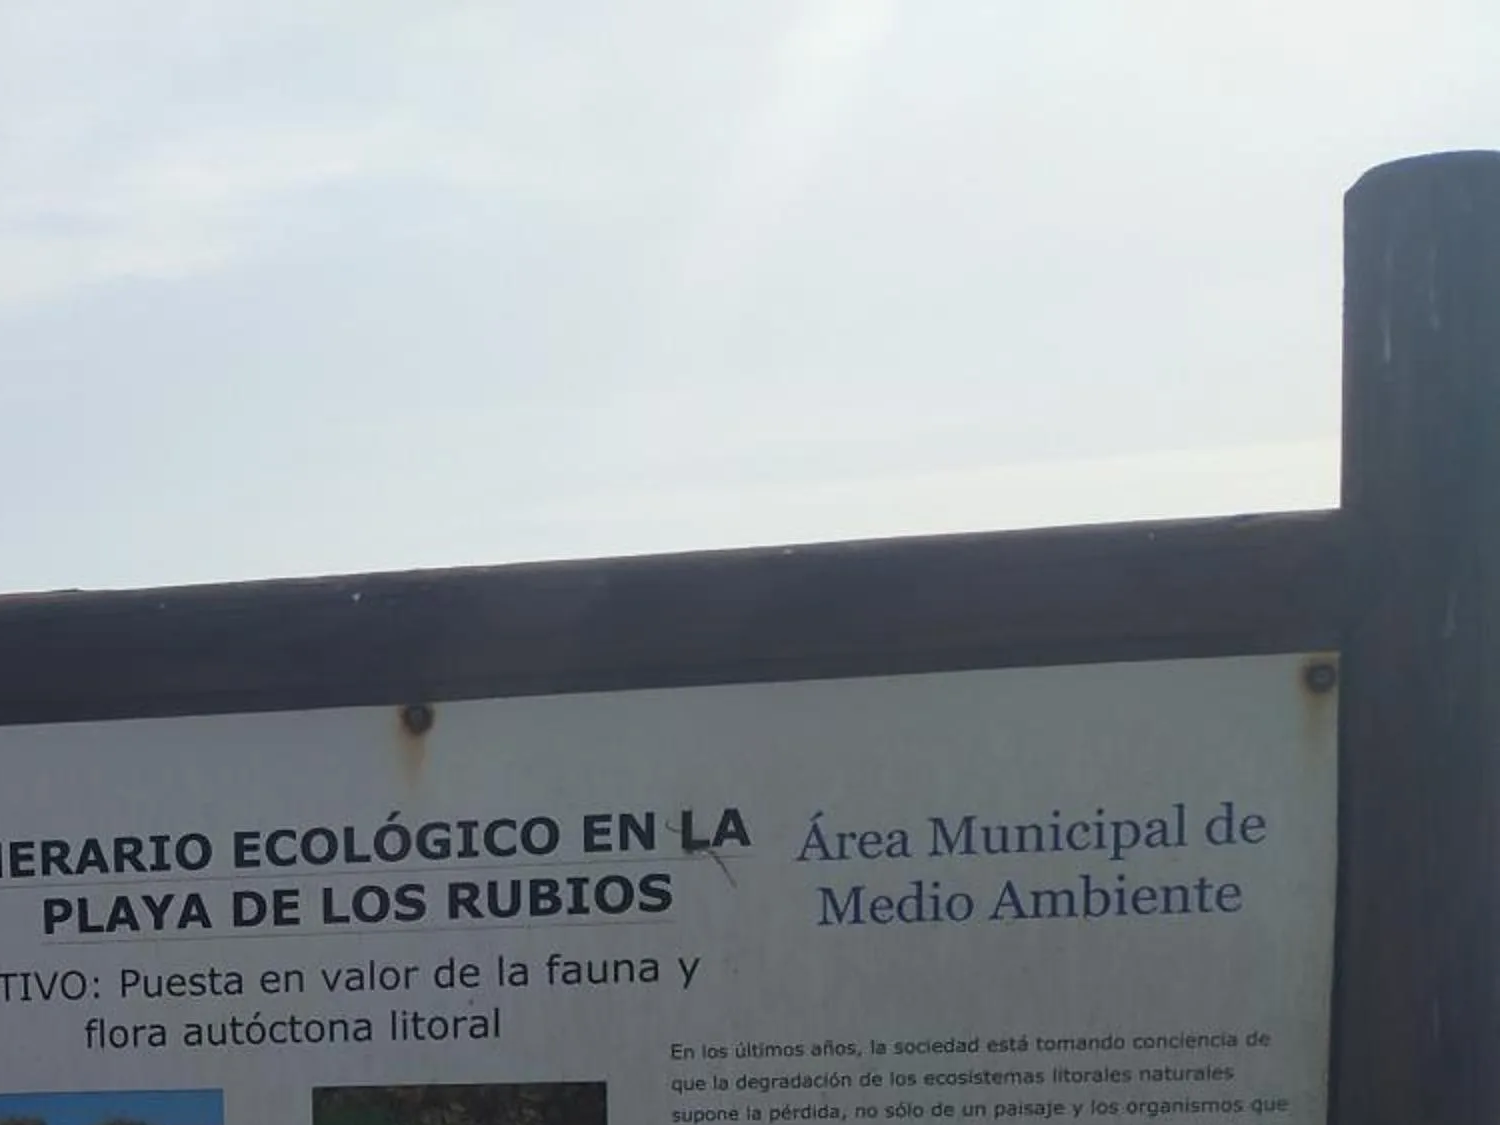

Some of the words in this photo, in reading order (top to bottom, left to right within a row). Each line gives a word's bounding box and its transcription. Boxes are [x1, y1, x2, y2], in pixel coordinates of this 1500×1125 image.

[234, 811, 559, 868] ECOLÓGICO
[584, 812, 655, 852] EN
[681, 808, 751, 851] LA
[796, 811, 911, 861] Área
[929, 803, 1186, 861] Municipal
[1205, 802, 1265, 845] de
[44, 893, 212, 934] PLAYA
[233, 889, 300, 927] DE
[323, 884, 426, 924] LOS
[449, 874, 672, 919] RUBIOS
[818, 880, 974, 925] Medio
[989, 874, 1241, 920] Ambiente
[121, 968, 243, 998] Puesta
[260, 970, 304, 994] en
[322, 960, 419, 992] valor
[434, 957, 480, 988] de
[498, 956, 528, 986] la
[546, 954, 658, 985] fauna
[678, 958, 700, 989] y
[85, 1018, 166, 1048] flora
[184, 1012, 372, 1046] autóctona
[391, 1007, 499, 1040] litoral
[670, 1043, 696, 1061] En
[701, 1044, 729, 1060] los
[734, 1041, 805, 1060] últimos
[810, 1039, 863, 1058] años,
[869, 1039, 887, 1056] la
[893, 1036, 980, 1056] sociedad
[986, 1034, 1029, 1054] está
[1035, 1033, 1126, 1052] tomando
[1132, 1031, 1239, 1051] conciencia
[1245, 1030, 1272, 1048] de
[670, 1078, 707, 1095] que
[712, 1074, 729, 1092] la
[735, 1071, 853, 1094] degradación
[858, 1071, 883, 1088] de
[889, 1071, 918, 1088] los
[922, 1069, 1046, 1087] ecosistemas
[1052, 1066, 1133, 1084] litorales
[1138, 1063, 1235, 1083] naturales
[671, 1108, 740, 1125] supone
[746, 1105, 762, 1122] la
[768, 1103, 847, 1124] pérdida,
[854, 1105, 879, 1119] no
[883, 1100, 925, 1119] sólo
[930, 1101, 955, 1118] de
[961, 1103, 987, 1118] un
[993, 1101, 1066, 1121] paisaje
[1071, 1103, 1084, 1119] y
[1090, 1098, 1120, 1116] los
[1125, 1096, 1244, 1119] organismos
[1249, 1097, 1290, 1117] que
